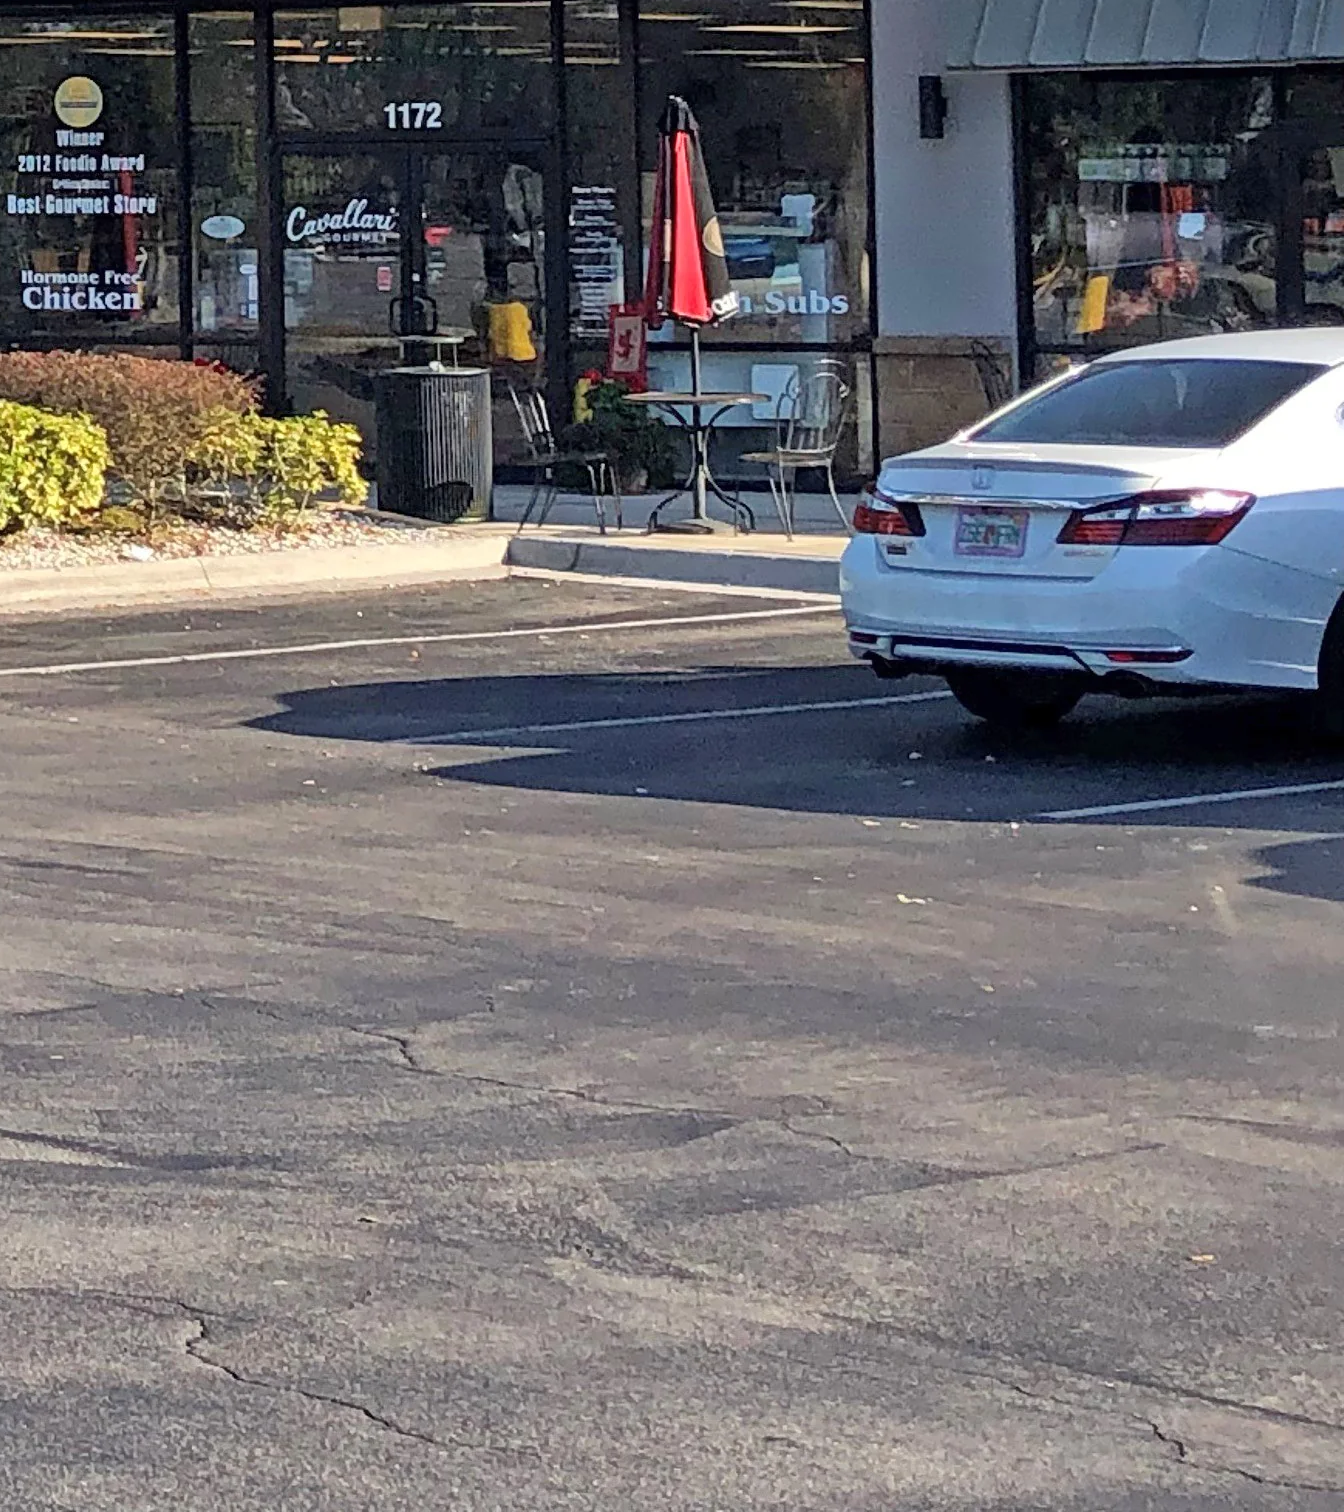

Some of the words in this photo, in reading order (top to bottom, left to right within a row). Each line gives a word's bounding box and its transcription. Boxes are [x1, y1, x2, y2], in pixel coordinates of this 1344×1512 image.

[383, 102, 442, 128] 1172
[56, 129, 104, 147] Winner
[18, 155, 51, 172] 2012
[101, 154, 145, 171] Award
[7, 194, 41, 214] Best
[45, 194, 109, 214] Gourmet
[114, 194, 157, 214] Store
[286, 198, 398, 242] Cavallari
[21, 270, 99, 284] Hormone
[105, 270, 141, 285] Free
[22, 287, 141, 310] Chicken
[765, 289, 848, 314] Subs
